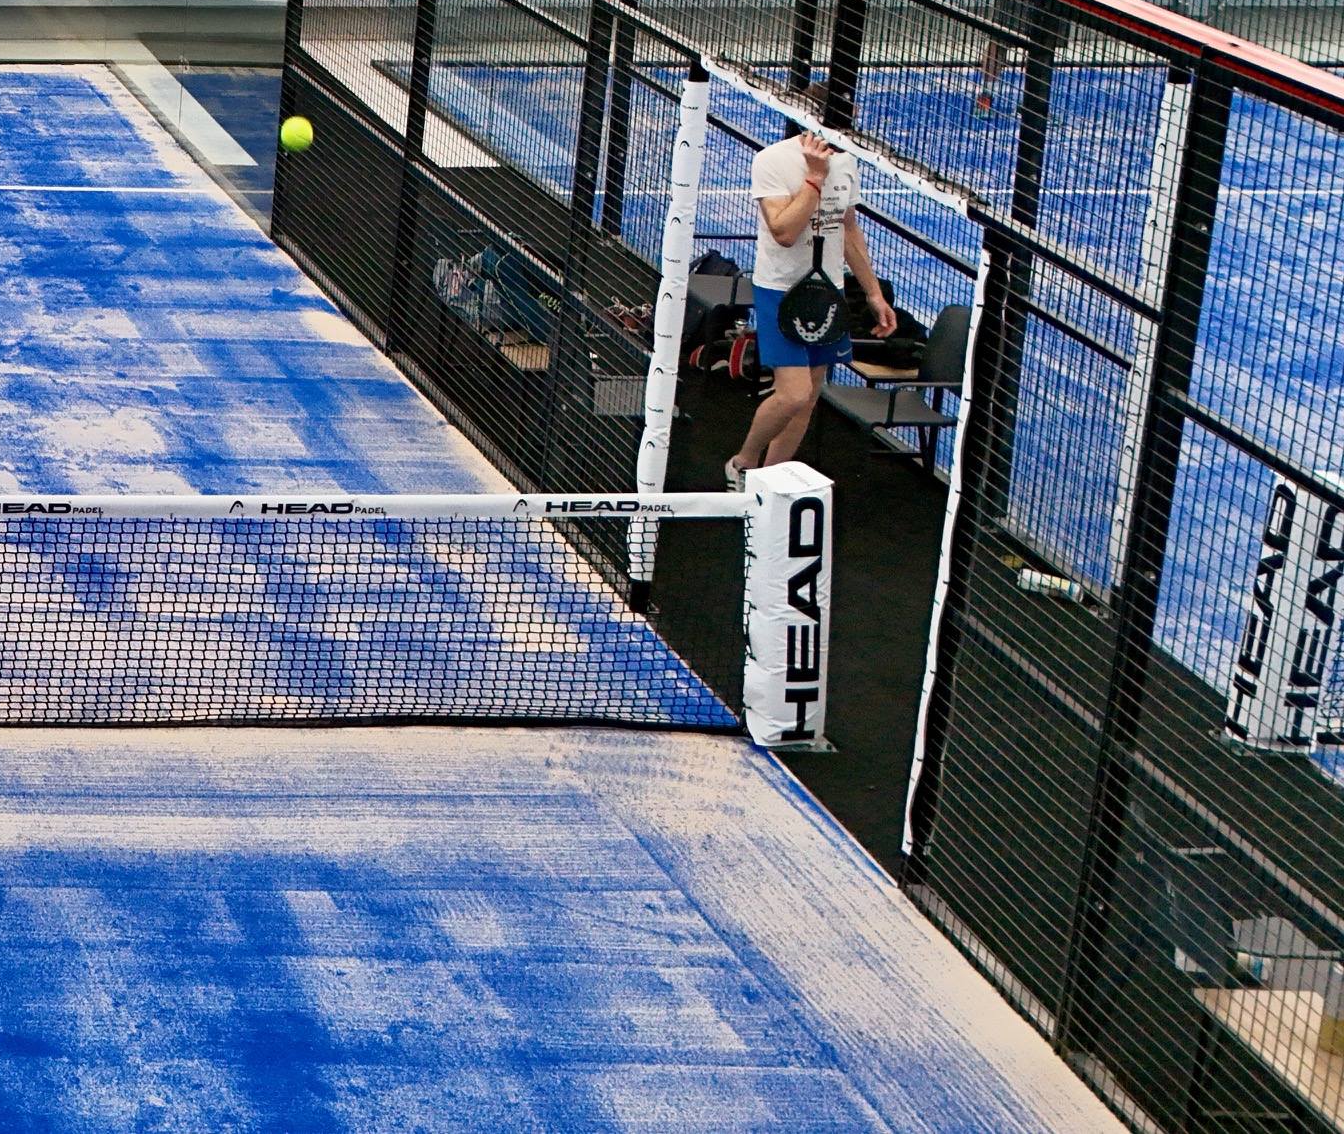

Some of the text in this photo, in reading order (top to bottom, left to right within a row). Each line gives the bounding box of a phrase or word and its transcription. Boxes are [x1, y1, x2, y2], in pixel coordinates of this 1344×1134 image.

[261, 503, 353, 516] HEAD
[546, 501, 639, 513] HEAD
[781, 496, 825, 741] HEAD
